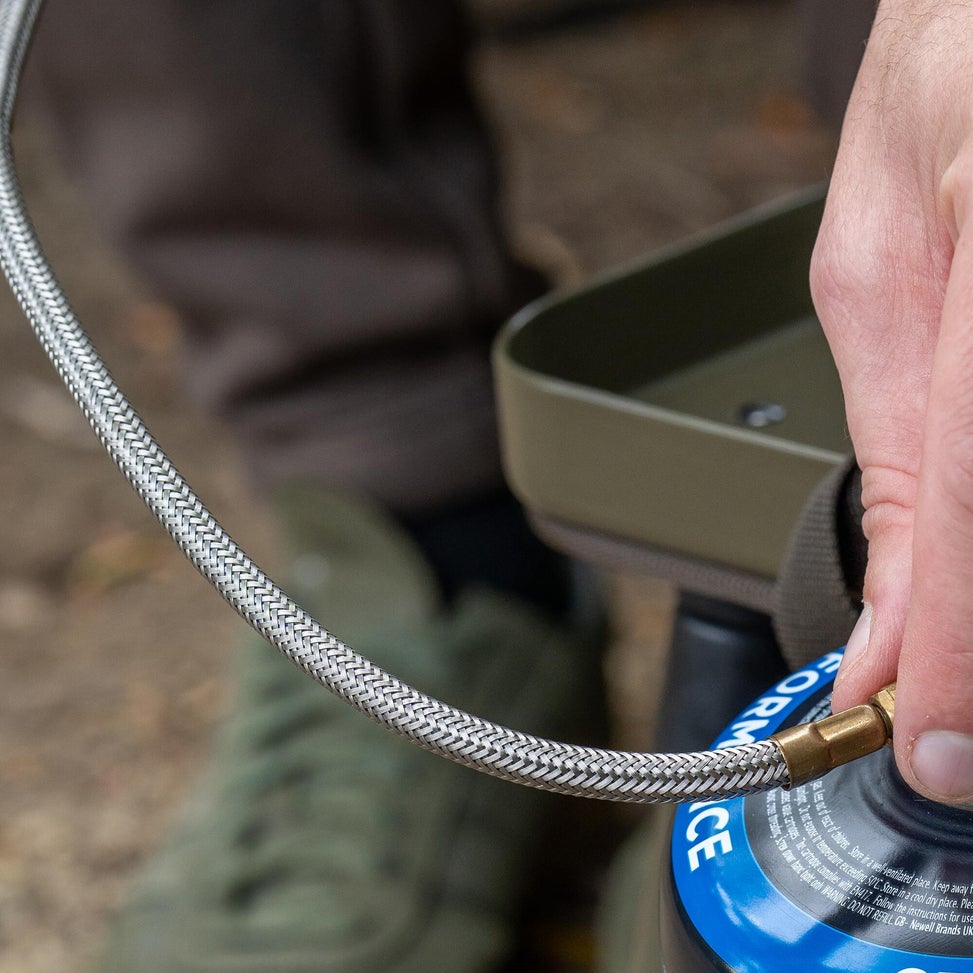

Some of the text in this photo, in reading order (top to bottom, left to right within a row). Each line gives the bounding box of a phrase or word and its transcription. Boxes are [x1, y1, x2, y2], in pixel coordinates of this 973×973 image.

[686, 652, 844, 872] FORMCE
[880, 882, 898, 896] Store
[897, 887, 906, 898] in
[904, 892, 911, 900] a
[910, 893, 927, 903] cool
[926, 894, 938, 908] dry
[938, 896, 958, 908] place.
[933, 880, 950, 894] Keep
[951, 885, 969, 896] away
[847, 900, 861, 911] DO
[857, 904, 875, 917] NOT
[909, 919, 935, 932] Newell
[935, 923, 961, 935] Brands
[963, 926, 973, 936] UK
[873, 895, 893, 909] Follow
[894, 902, 907, 914] the
[907, 905, 948, 921] instructions
[949, 911, 959, 922] for
[961, 915, 973, 923] use
